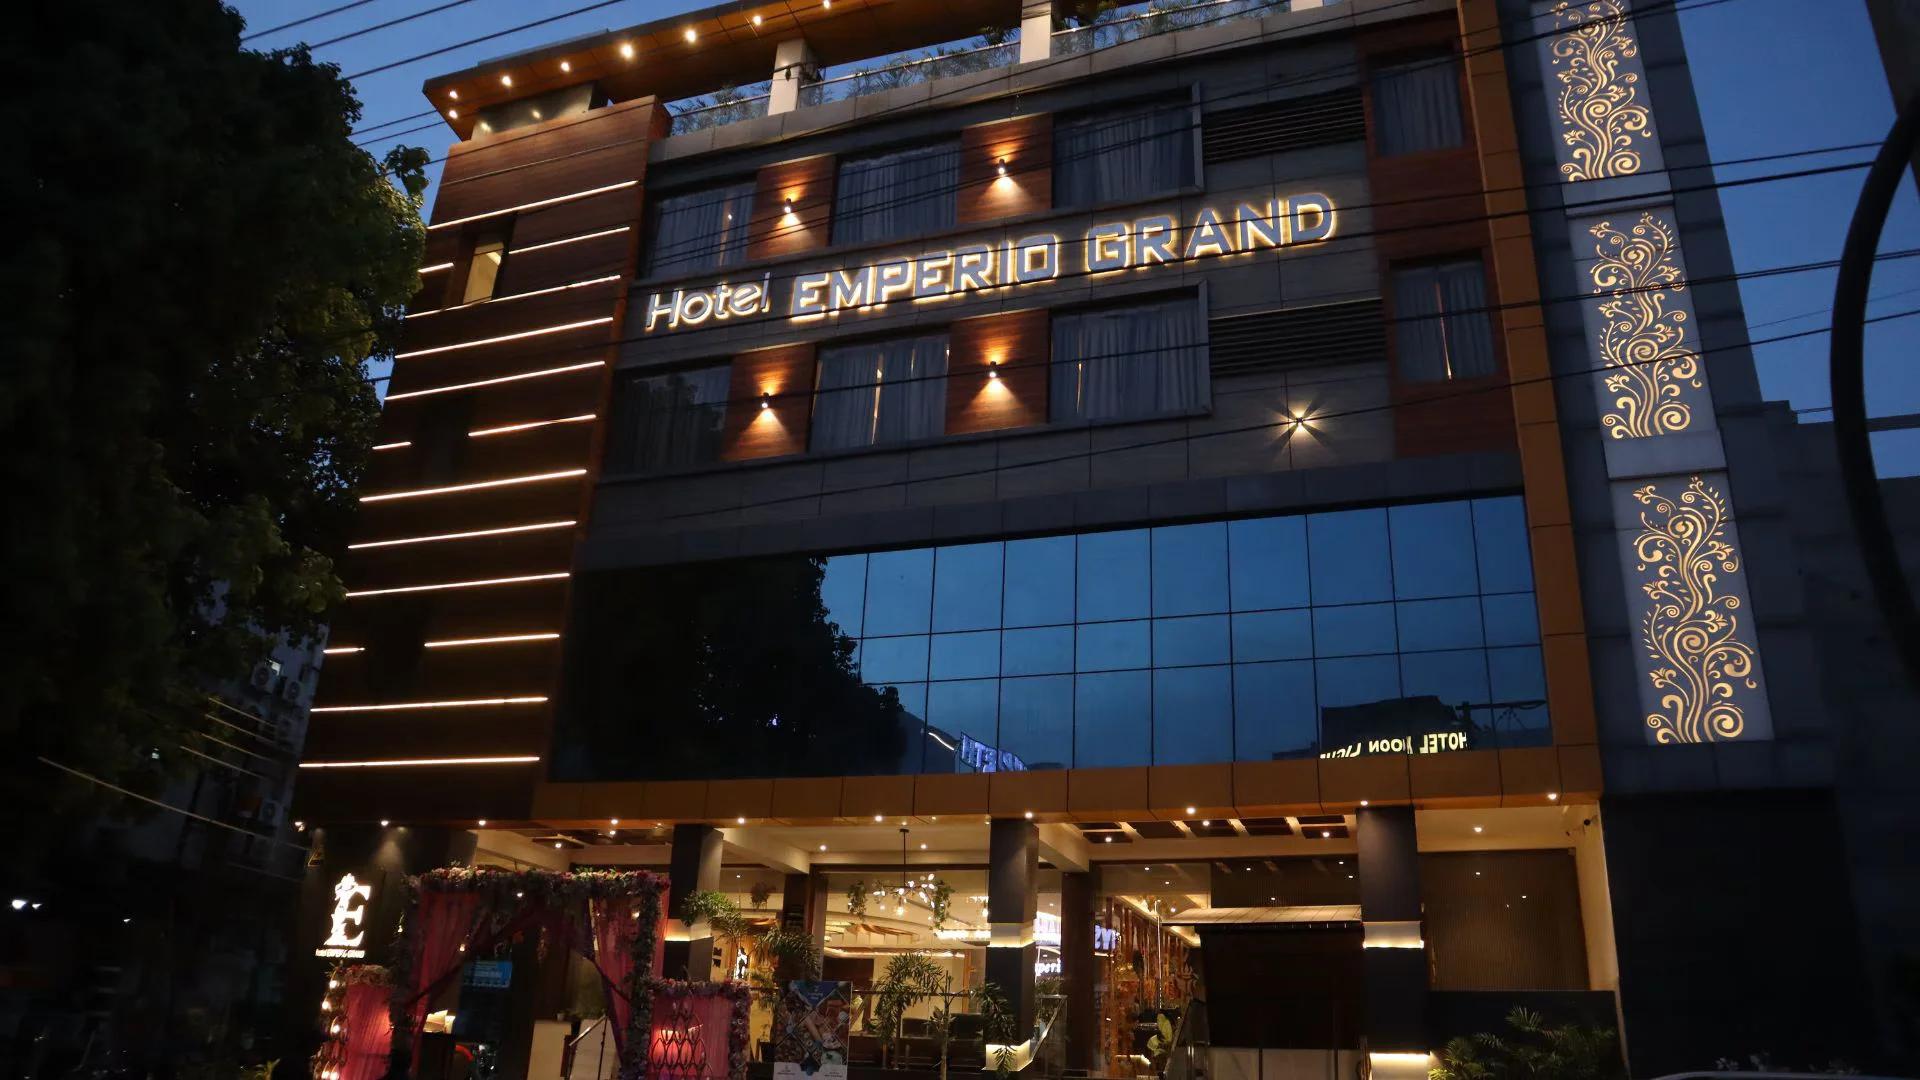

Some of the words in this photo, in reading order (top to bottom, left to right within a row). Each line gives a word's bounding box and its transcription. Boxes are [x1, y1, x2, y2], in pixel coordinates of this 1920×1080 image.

[645, 272, 771, 328] Hotel
[791, 235, 1060, 320] EMPERIO
[1086, 193, 1336, 275] GRAND
